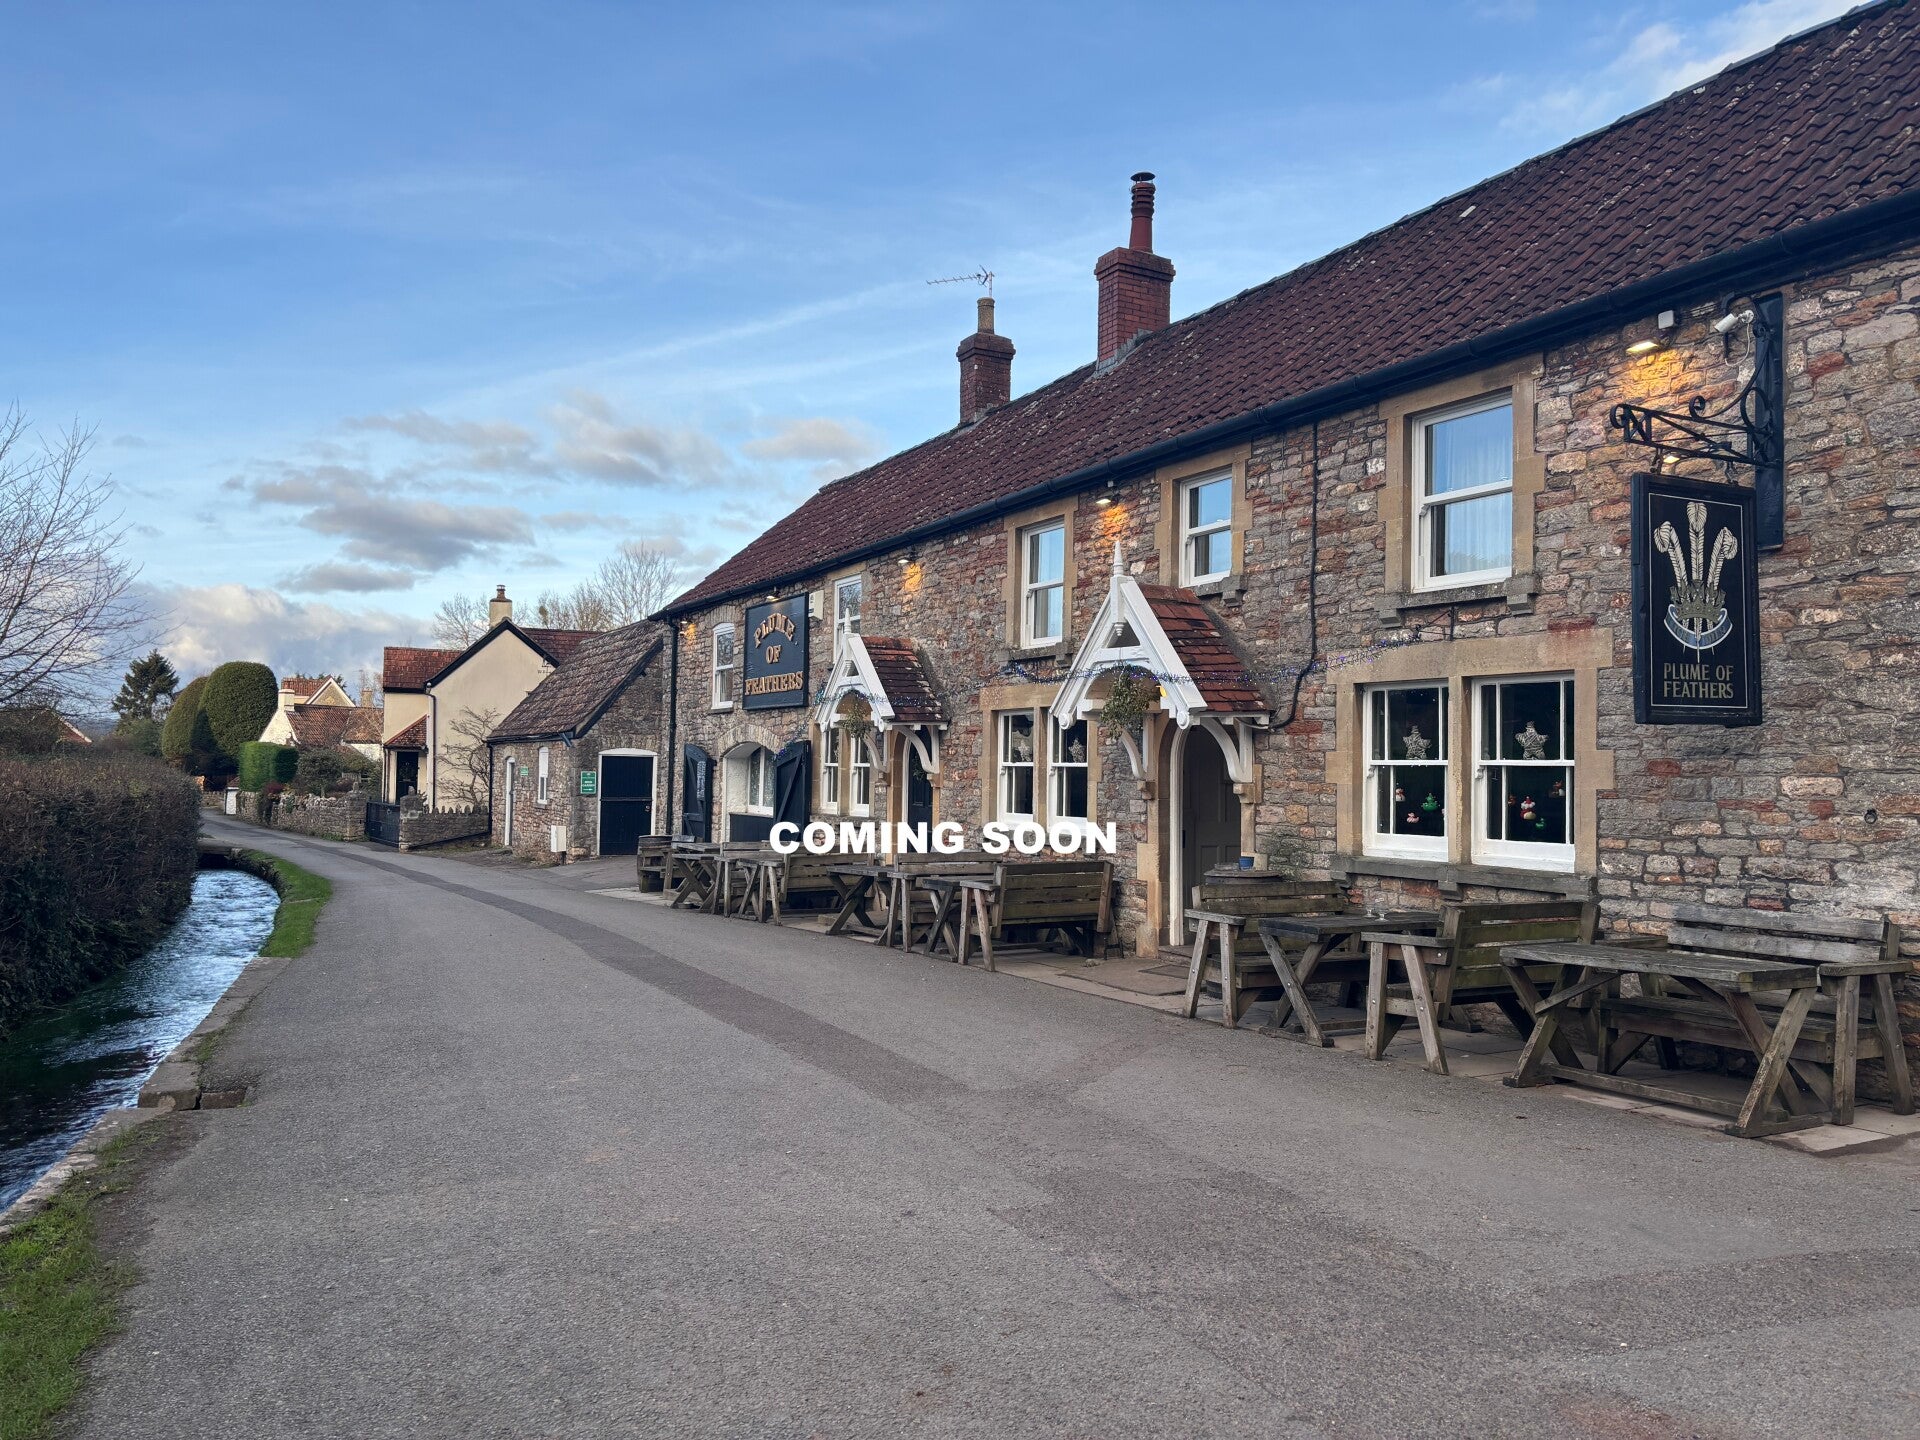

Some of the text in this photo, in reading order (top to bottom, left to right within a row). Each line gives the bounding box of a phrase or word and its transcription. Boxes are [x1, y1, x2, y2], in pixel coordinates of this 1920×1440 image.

[753, 612, 796, 648] PLUME
[766, 645, 781, 664] OF
[1664, 663, 1734, 681] PLUME OF
[744, 671, 803, 695] FEATHERS
[1664, 681, 1734, 698] FEATHERS
